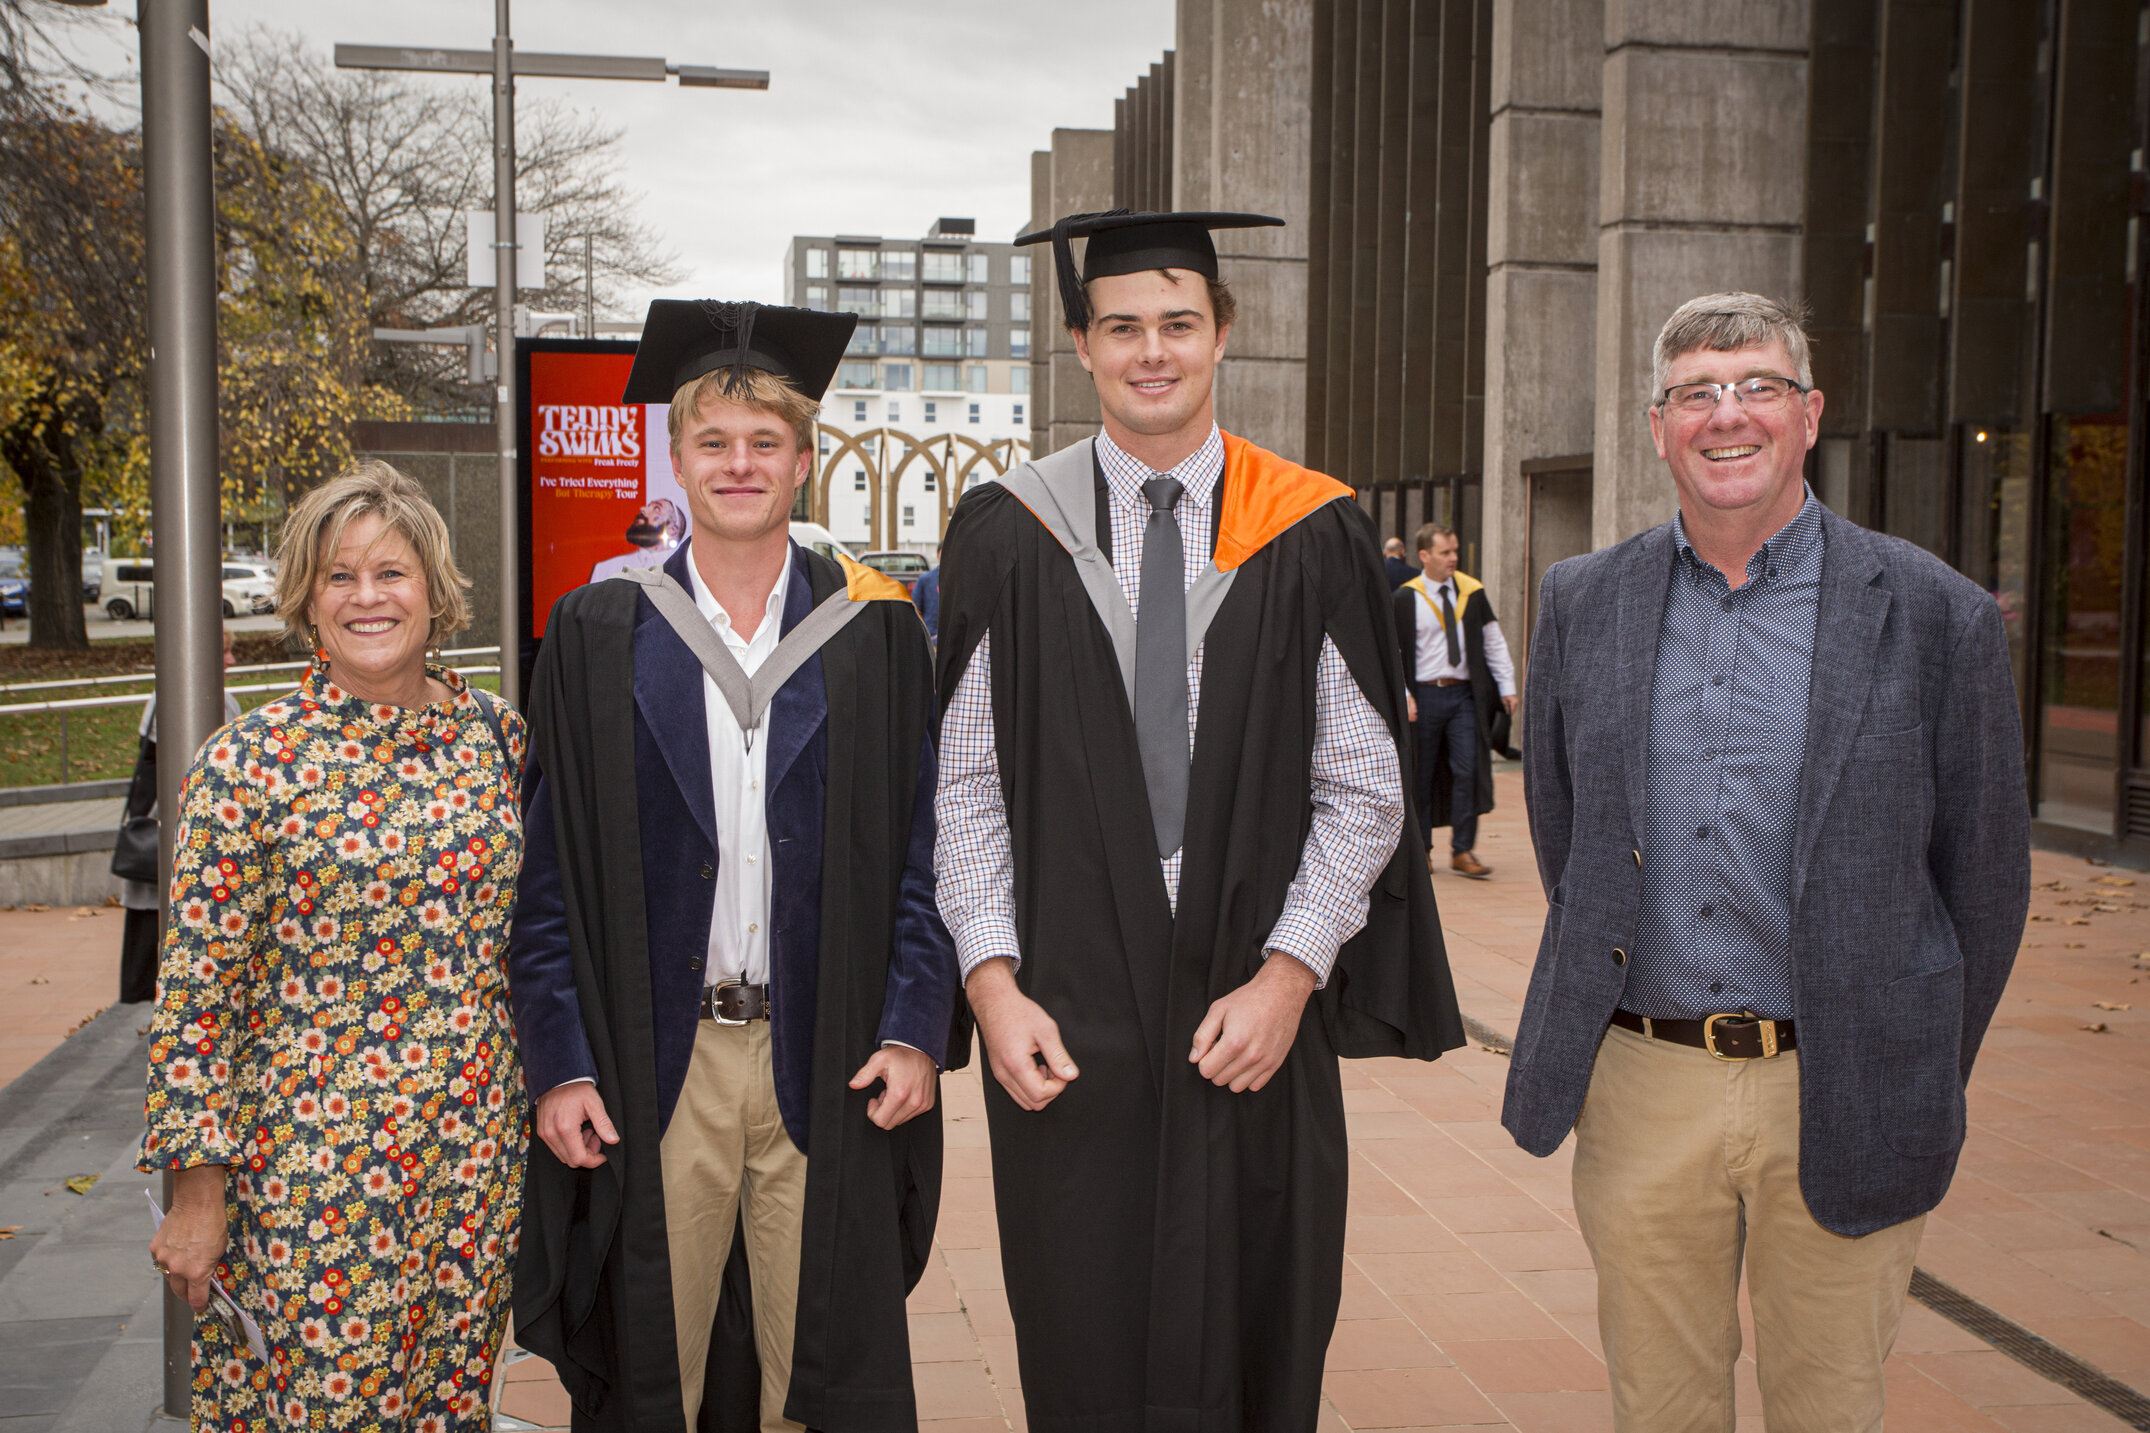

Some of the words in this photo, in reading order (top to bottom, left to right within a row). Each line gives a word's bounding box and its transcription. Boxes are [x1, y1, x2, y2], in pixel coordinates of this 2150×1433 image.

[539, 405, 637, 432] TEDDY
[539, 431, 640, 457] SWIMS
[594, 458, 615, 467] Freak
[616, 459, 639, 468] Freely
[540, 476, 557, 487] I've
[559, 476, 585, 487] Tried
[587, 477, 639, 489] Everything
[555, 488, 570, 498] But
[574, 489, 613, 500] Therapy
[615, 489, 638, 499] Tour
